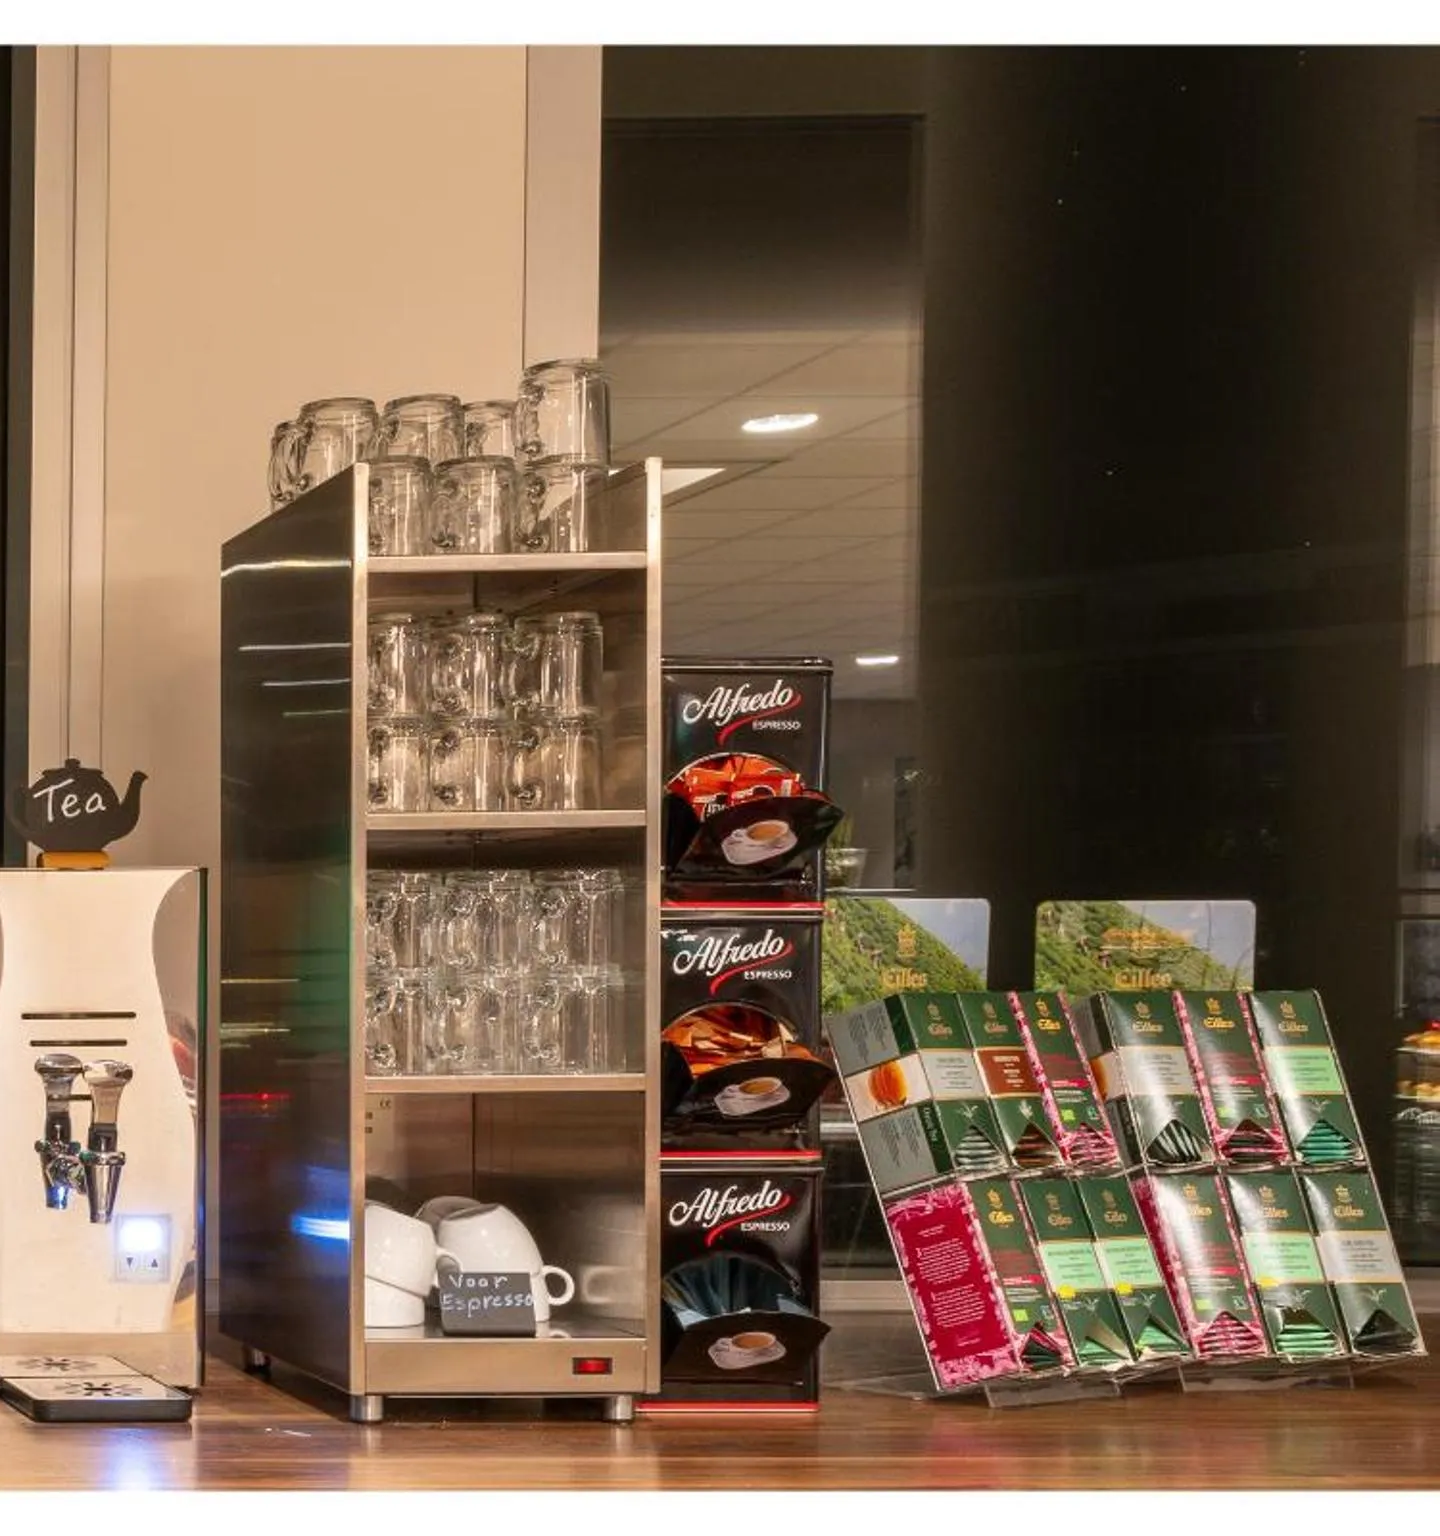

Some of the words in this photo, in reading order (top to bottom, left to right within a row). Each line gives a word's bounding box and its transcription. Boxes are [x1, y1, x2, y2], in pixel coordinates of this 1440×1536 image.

[682, 679, 794, 726] Alfredo
[751, 720, 802, 731] ESPRESSO
[33, 779, 106, 822] Tea
[672, 929, 785, 977] Alfredo
[744, 970, 792, 980] ESPRESSO
[669, 1180, 783, 1228] Alfredo
[740, 1222, 790, 1232] ESPRESSO
[448, 1274, 508, 1289] Voor
[442, 1293, 534, 1318] Espresso
